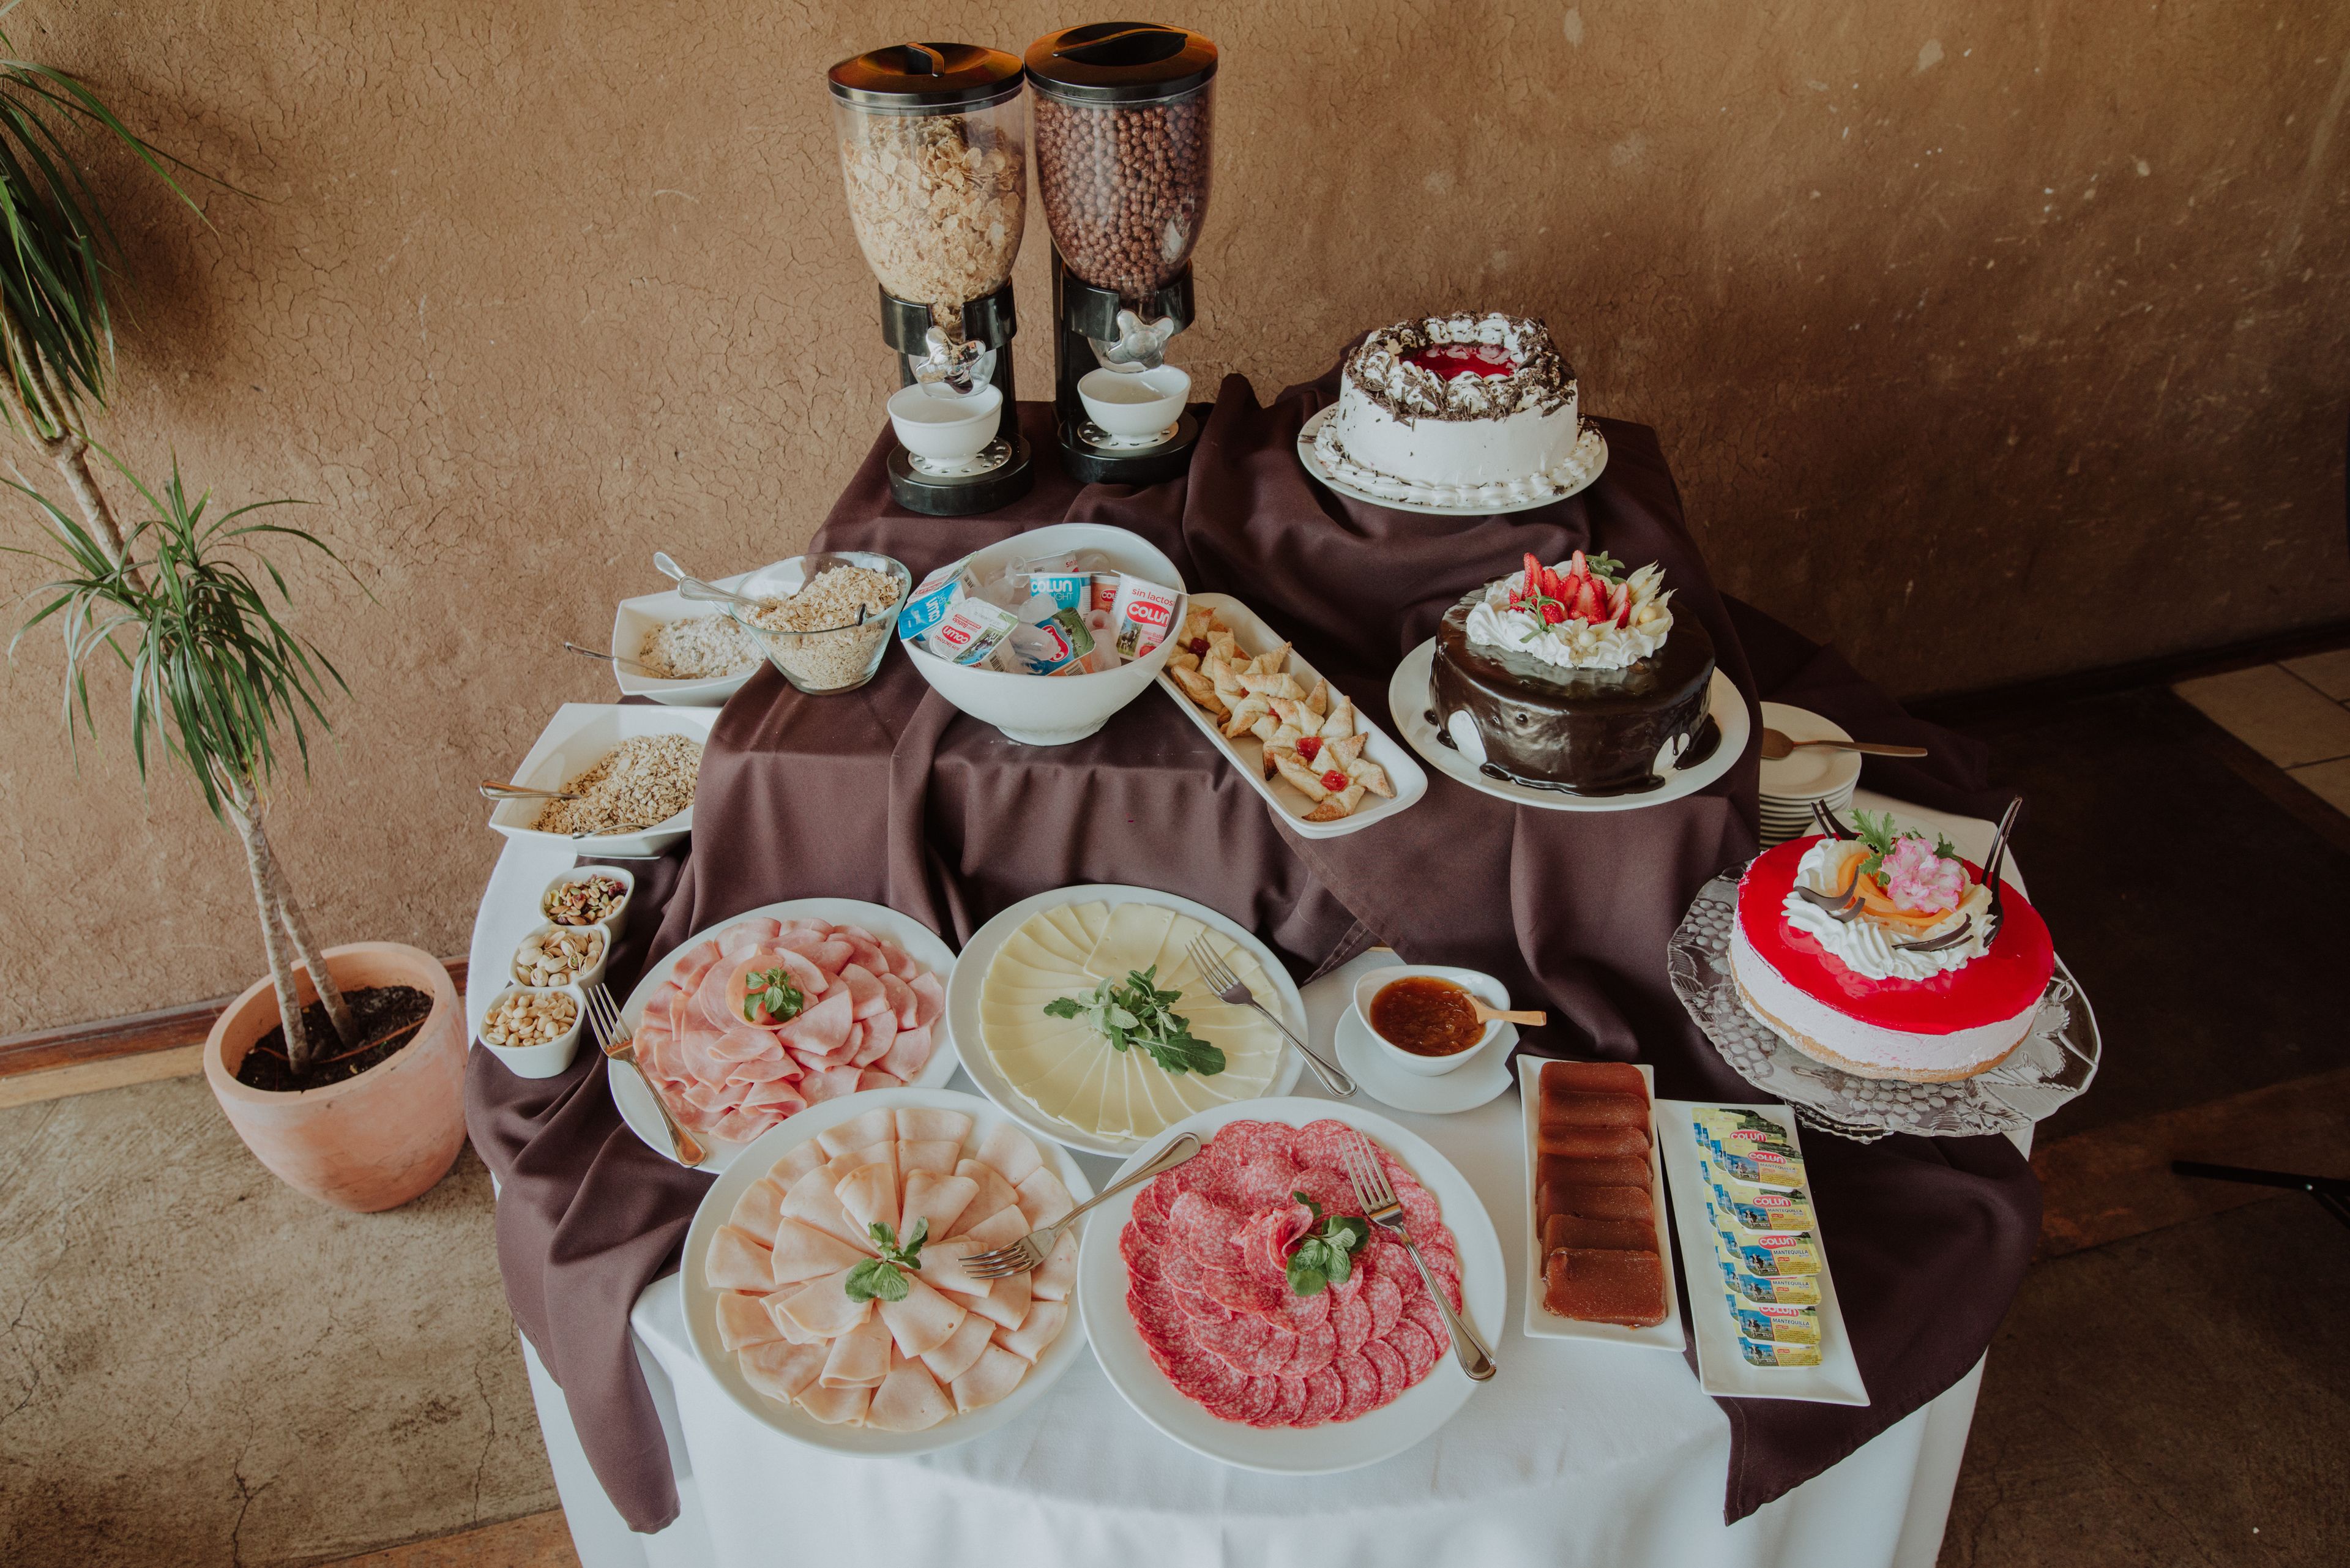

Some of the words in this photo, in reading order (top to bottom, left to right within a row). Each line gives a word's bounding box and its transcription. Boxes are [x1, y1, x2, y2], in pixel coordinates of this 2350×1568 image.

[1031, 580, 1073, 592] COLUN
[1132, 588, 1146, 598] sin
[925, 596, 941, 622] COLUN
[1129, 603, 1169, 626] COLUN
[952, 617, 968, 629] Batido
[934, 634, 953, 648] lactosa
[943, 626, 969, 644] COLUN
[1731, 1133, 1764, 1141] COLUN
[1748, 1152, 1785, 1164] COLUN
[1753, 1197, 1789, 1206] COLUN
[1759, 1238, 1794, 1246] COLUN
